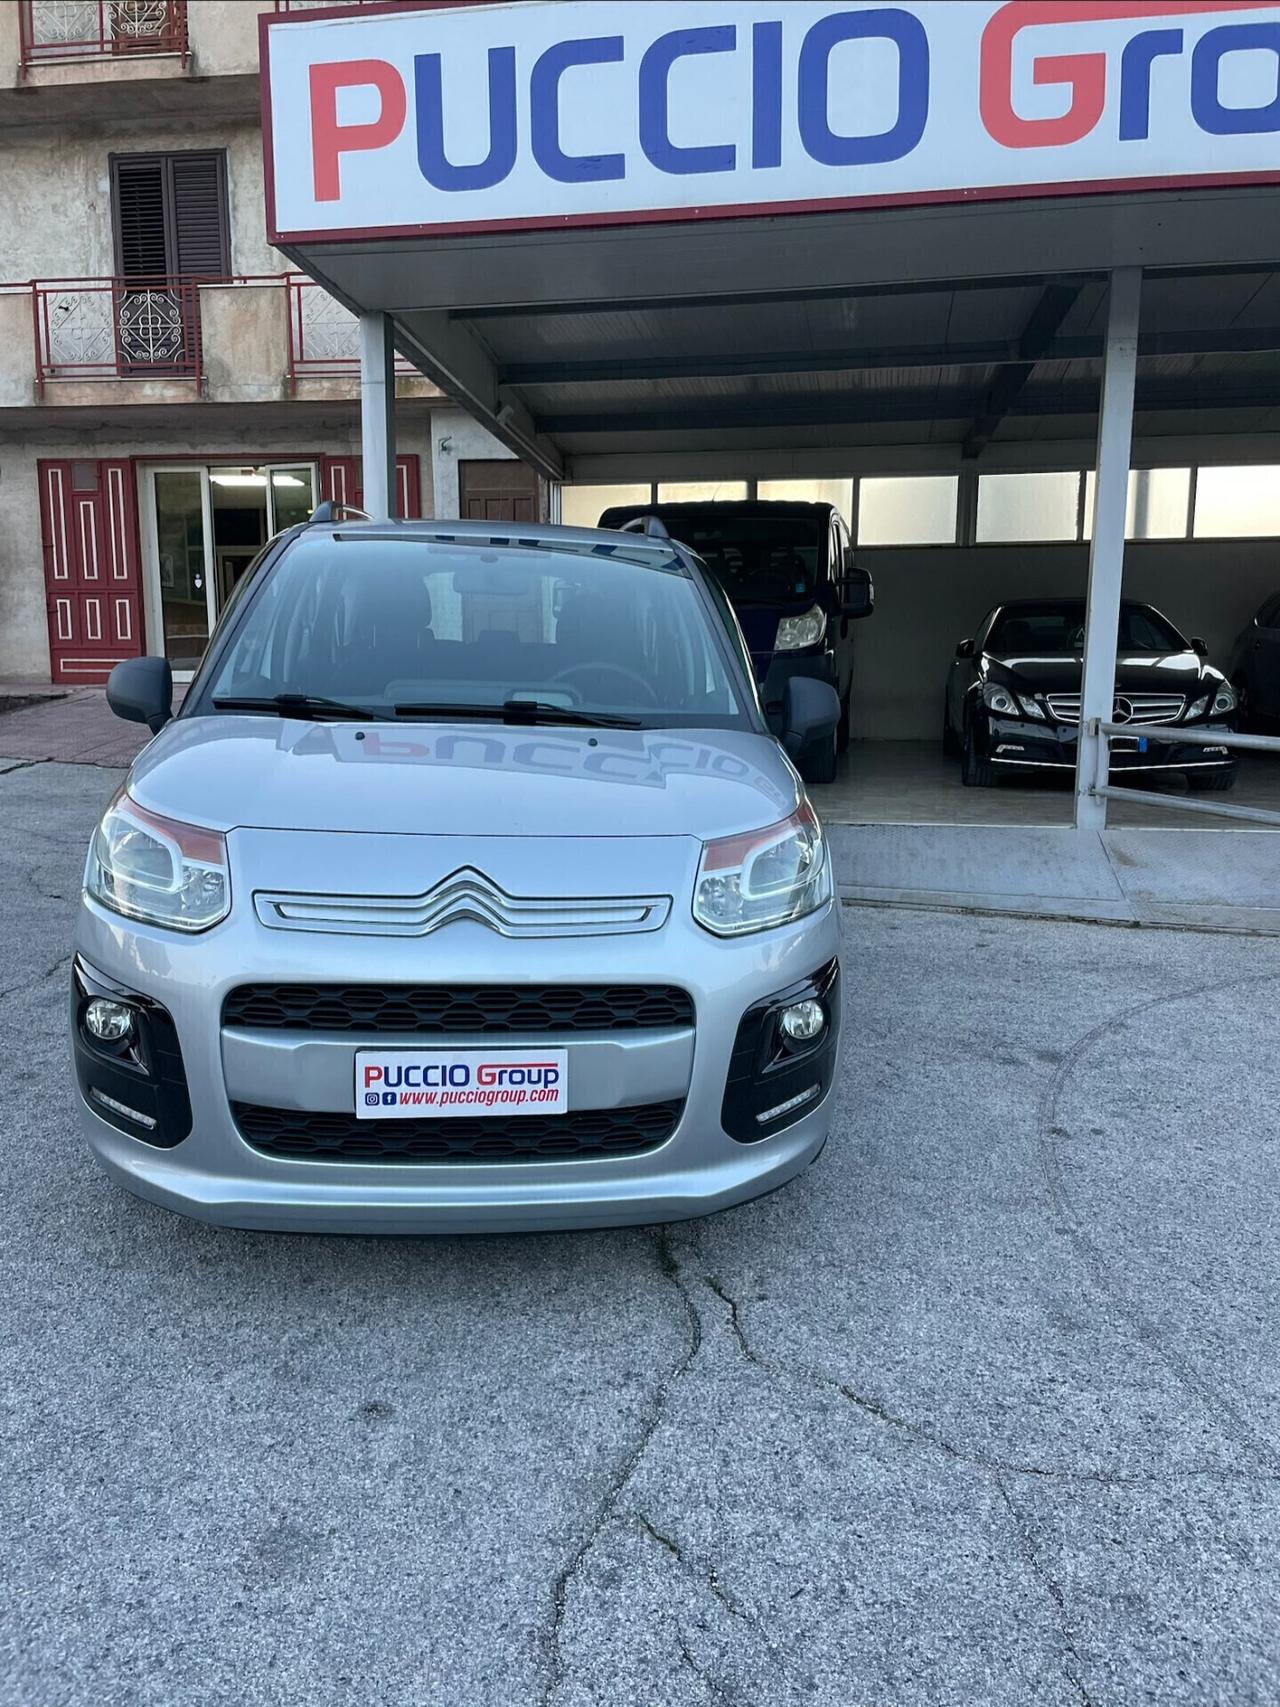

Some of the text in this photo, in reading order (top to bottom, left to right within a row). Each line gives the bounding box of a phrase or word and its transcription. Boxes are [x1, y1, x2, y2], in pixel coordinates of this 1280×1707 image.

[308, 7, 930, 202] PUCCIO
[364, 1063, 559, 1089] PUCCIO Group
[399, 1088, 559, 1107] www.pucciogroup.com
